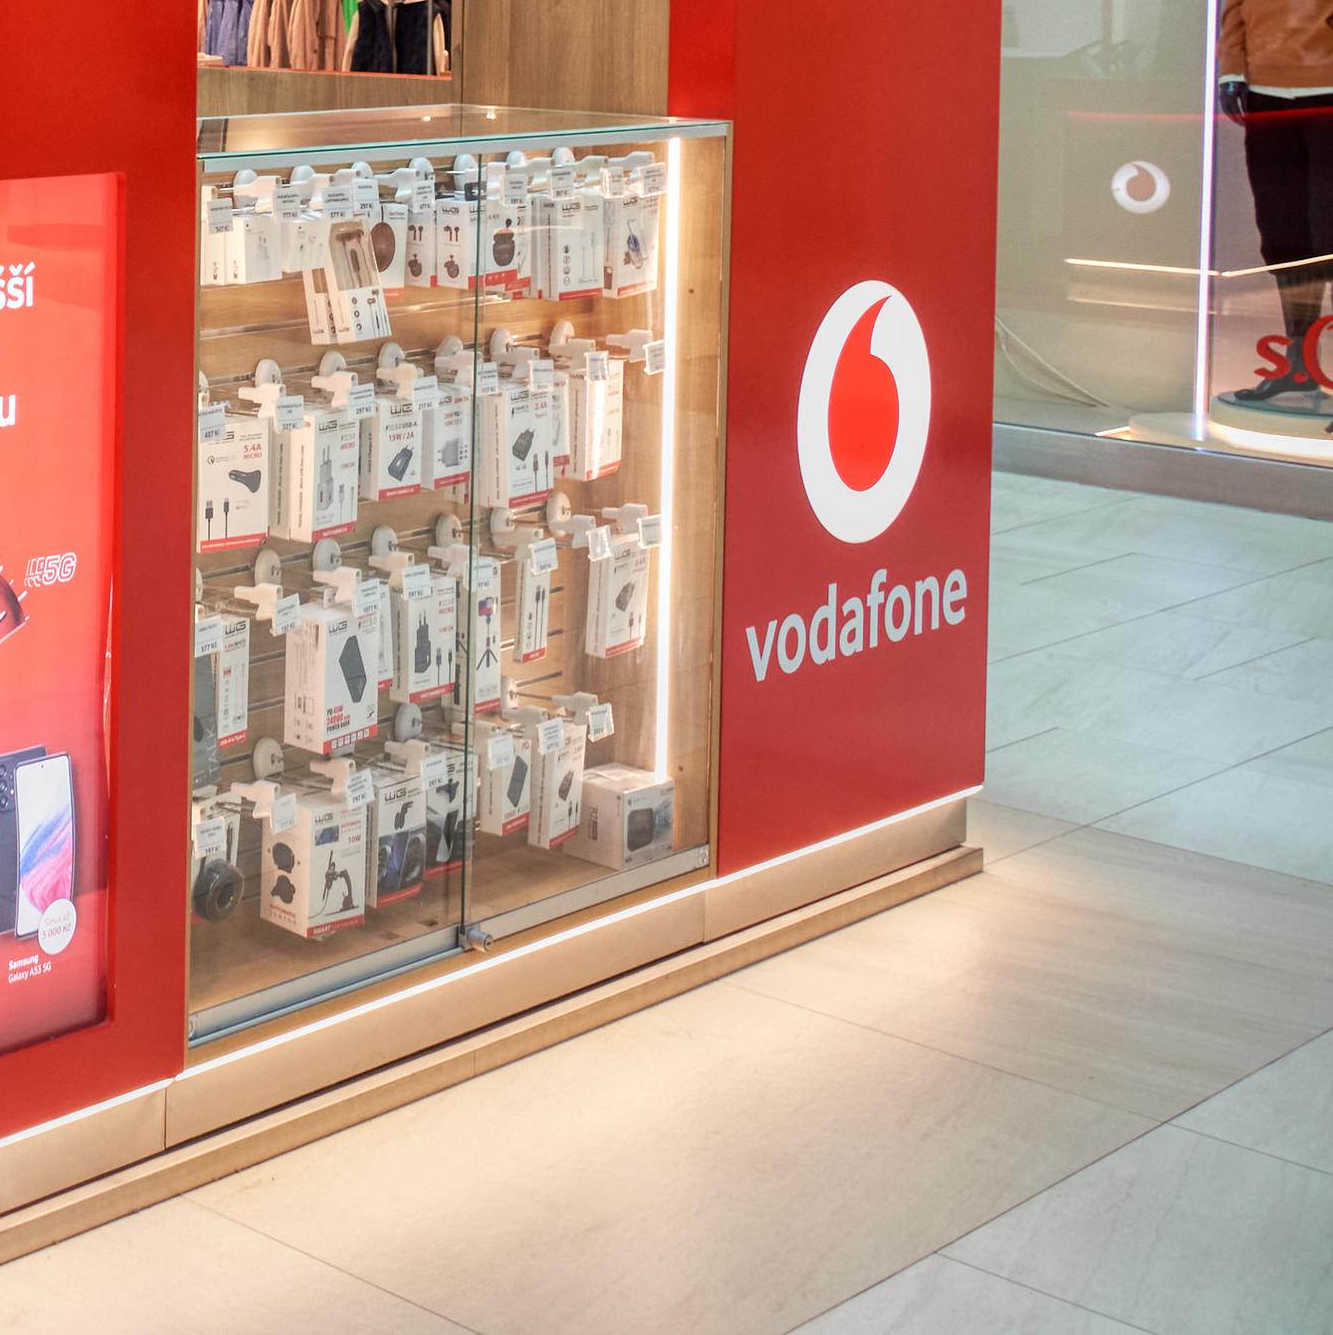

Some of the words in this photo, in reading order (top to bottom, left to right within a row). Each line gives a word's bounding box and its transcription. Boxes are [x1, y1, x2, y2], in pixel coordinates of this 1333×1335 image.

[41, 552, 77, 585] 5G
[745, 568, 968, 683] vodafone
[8, 954, 39, 970] Samsung
[8, 970, 29, 984] Galaxy
